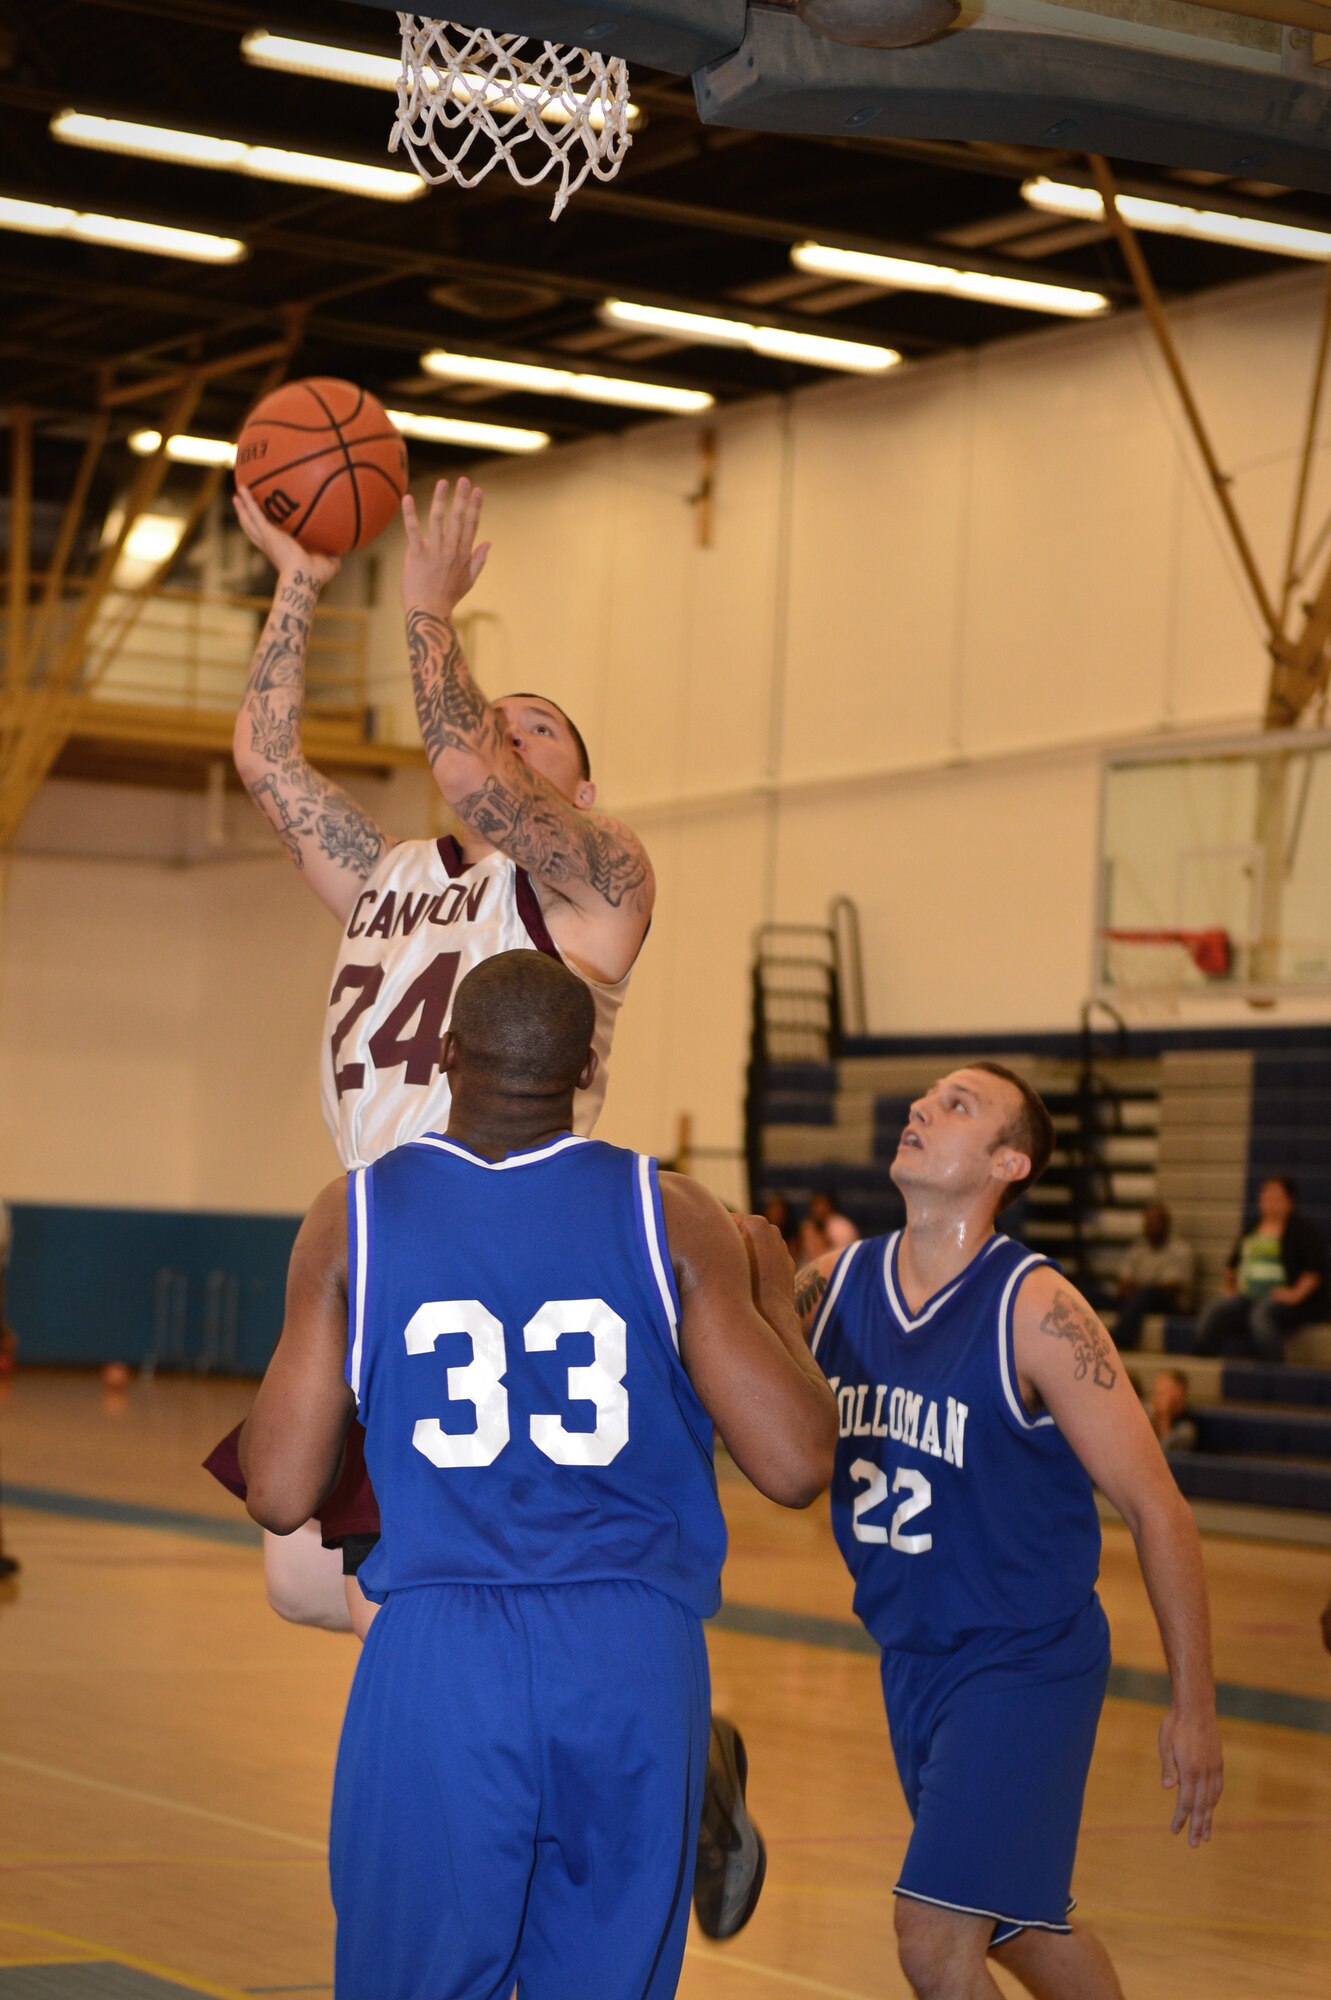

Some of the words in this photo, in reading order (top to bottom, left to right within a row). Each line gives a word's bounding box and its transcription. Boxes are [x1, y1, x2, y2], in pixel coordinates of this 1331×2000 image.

[329, 950, 462, 1100] 24
[403, 1297, 630, 1468] 33
[849, 1457, 933, 1555] 22
